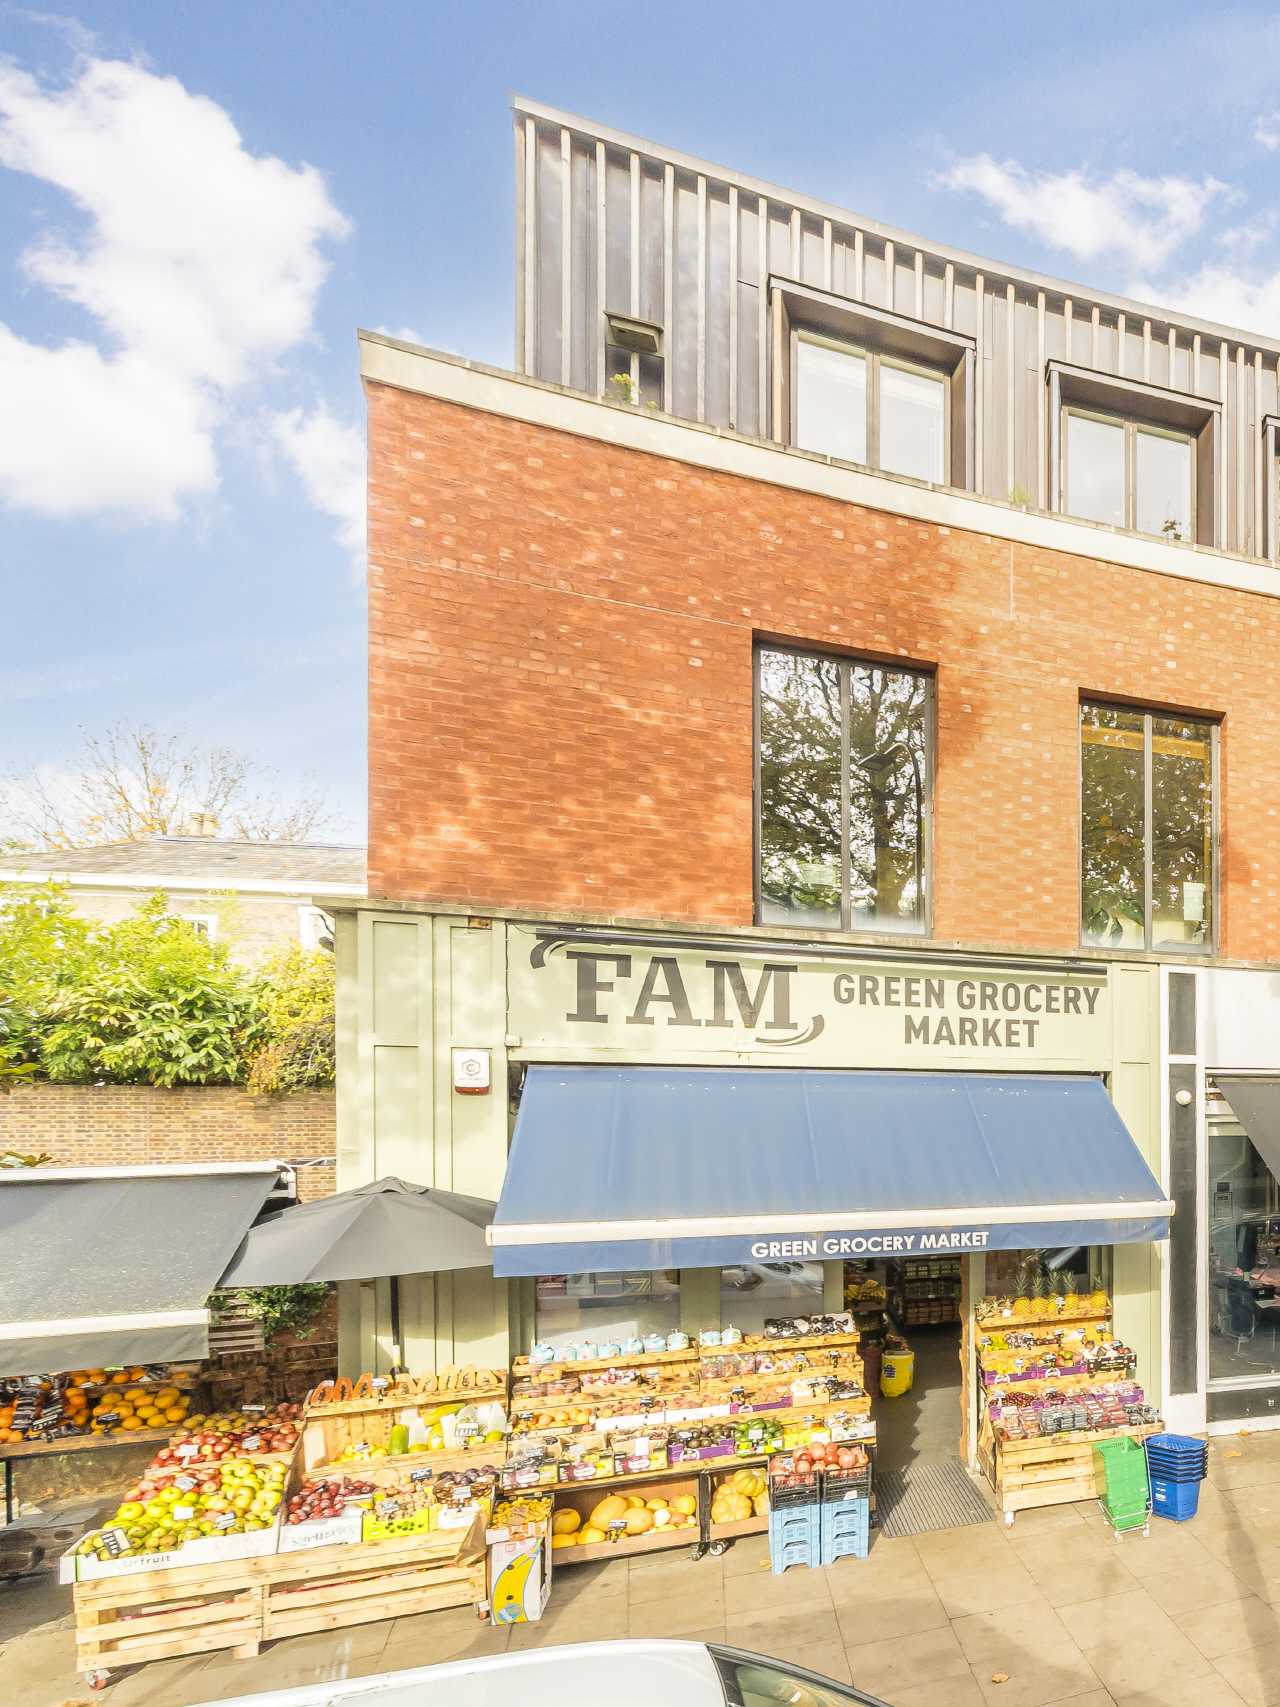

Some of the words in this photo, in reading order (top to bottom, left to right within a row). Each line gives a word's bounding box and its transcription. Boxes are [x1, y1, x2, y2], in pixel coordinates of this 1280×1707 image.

[566, 950, 798, 1030] FAM
[833, 973, 945, 1009] GREEN
[956, 980, 1100, 1015] GROCERY
[904, 1014, 1040, 1048] MARKET
[751, 1239, 817, 1258] GREEN
[823, 1235, 915, 1254] GROCERY
[919, 1231, 990, 1249] MARKET
